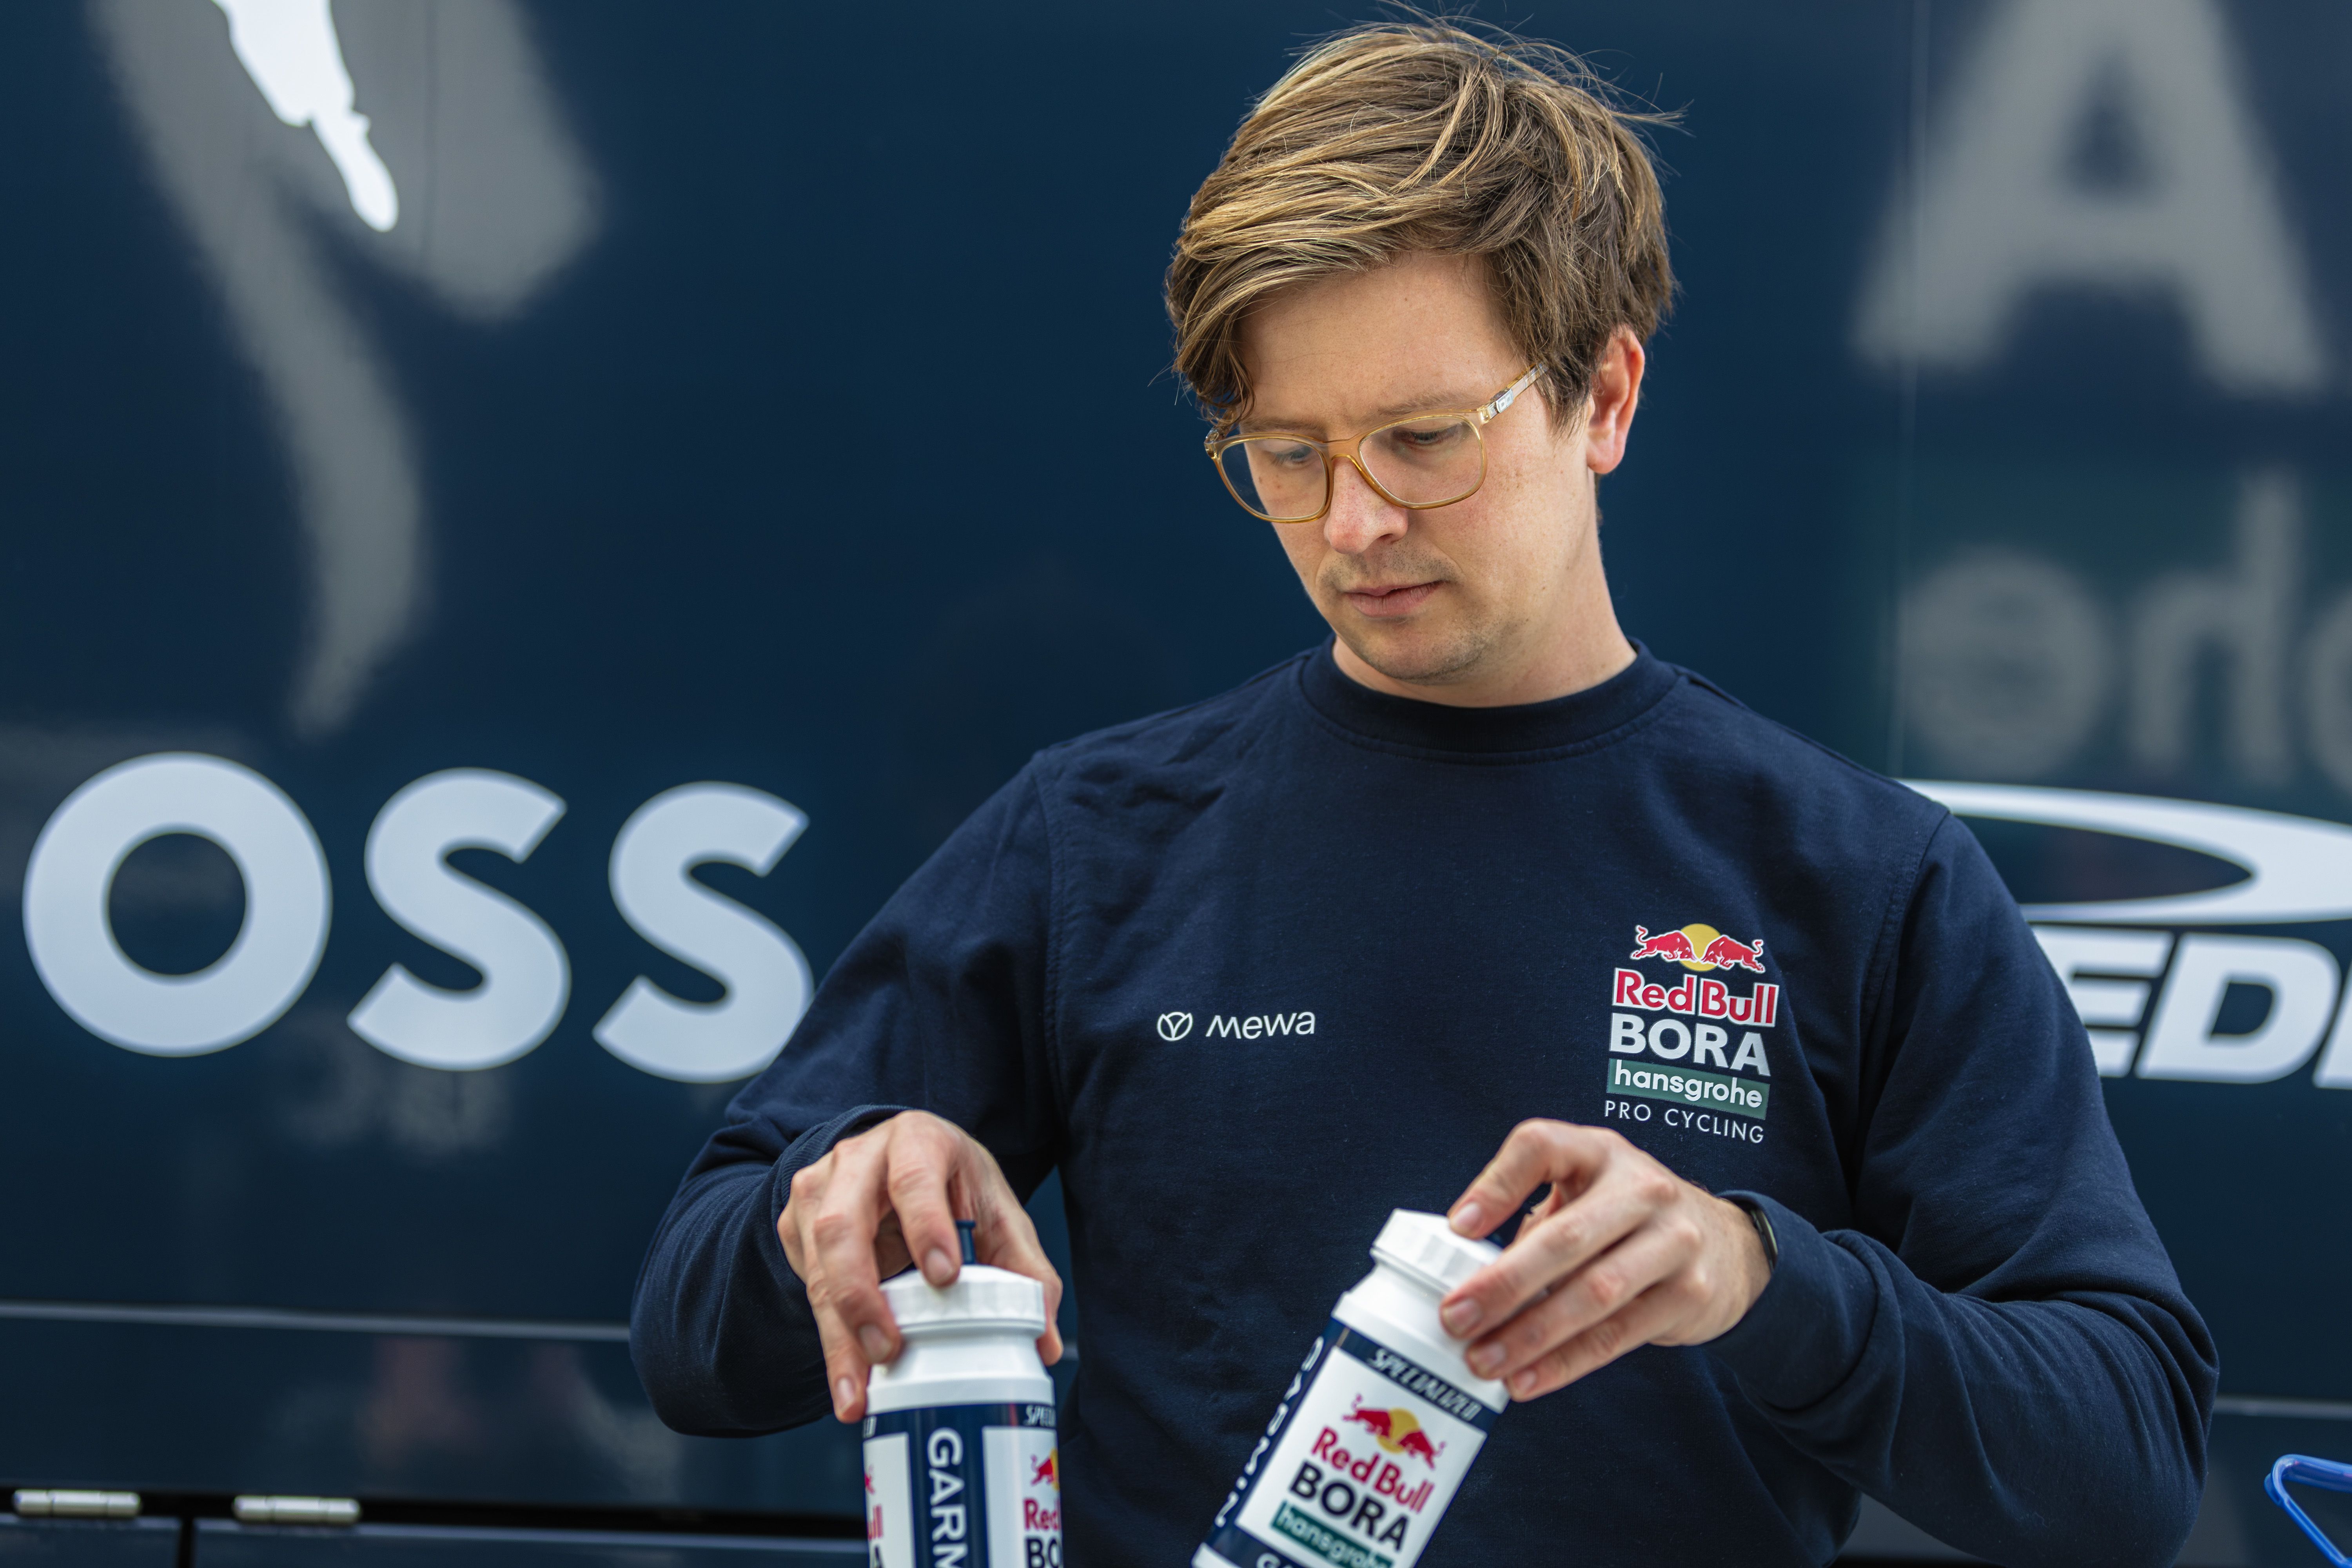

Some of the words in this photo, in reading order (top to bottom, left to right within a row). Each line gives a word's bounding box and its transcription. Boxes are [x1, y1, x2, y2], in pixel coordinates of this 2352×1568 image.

[22, 750, 815, 1084] OSS
[1612, 968, 1697, 1015] Red
[1699, 978, 1779, 1027] Bull
[2030, 924, 2352, 1091] ED
[1609, 1013, 1771, 1077] BORA
[1615, 1059, 1762, 1108] hansgrohe
[1604, 1100, 1651, 1122] PRO
[1665, 1109, 1764, 1144] CYCLING
[1289, 1461, 1410, 1552] BORA
[1310, 1426, 1382, 1483] Red
[1374, 1461, 1436, 1514] Bull
